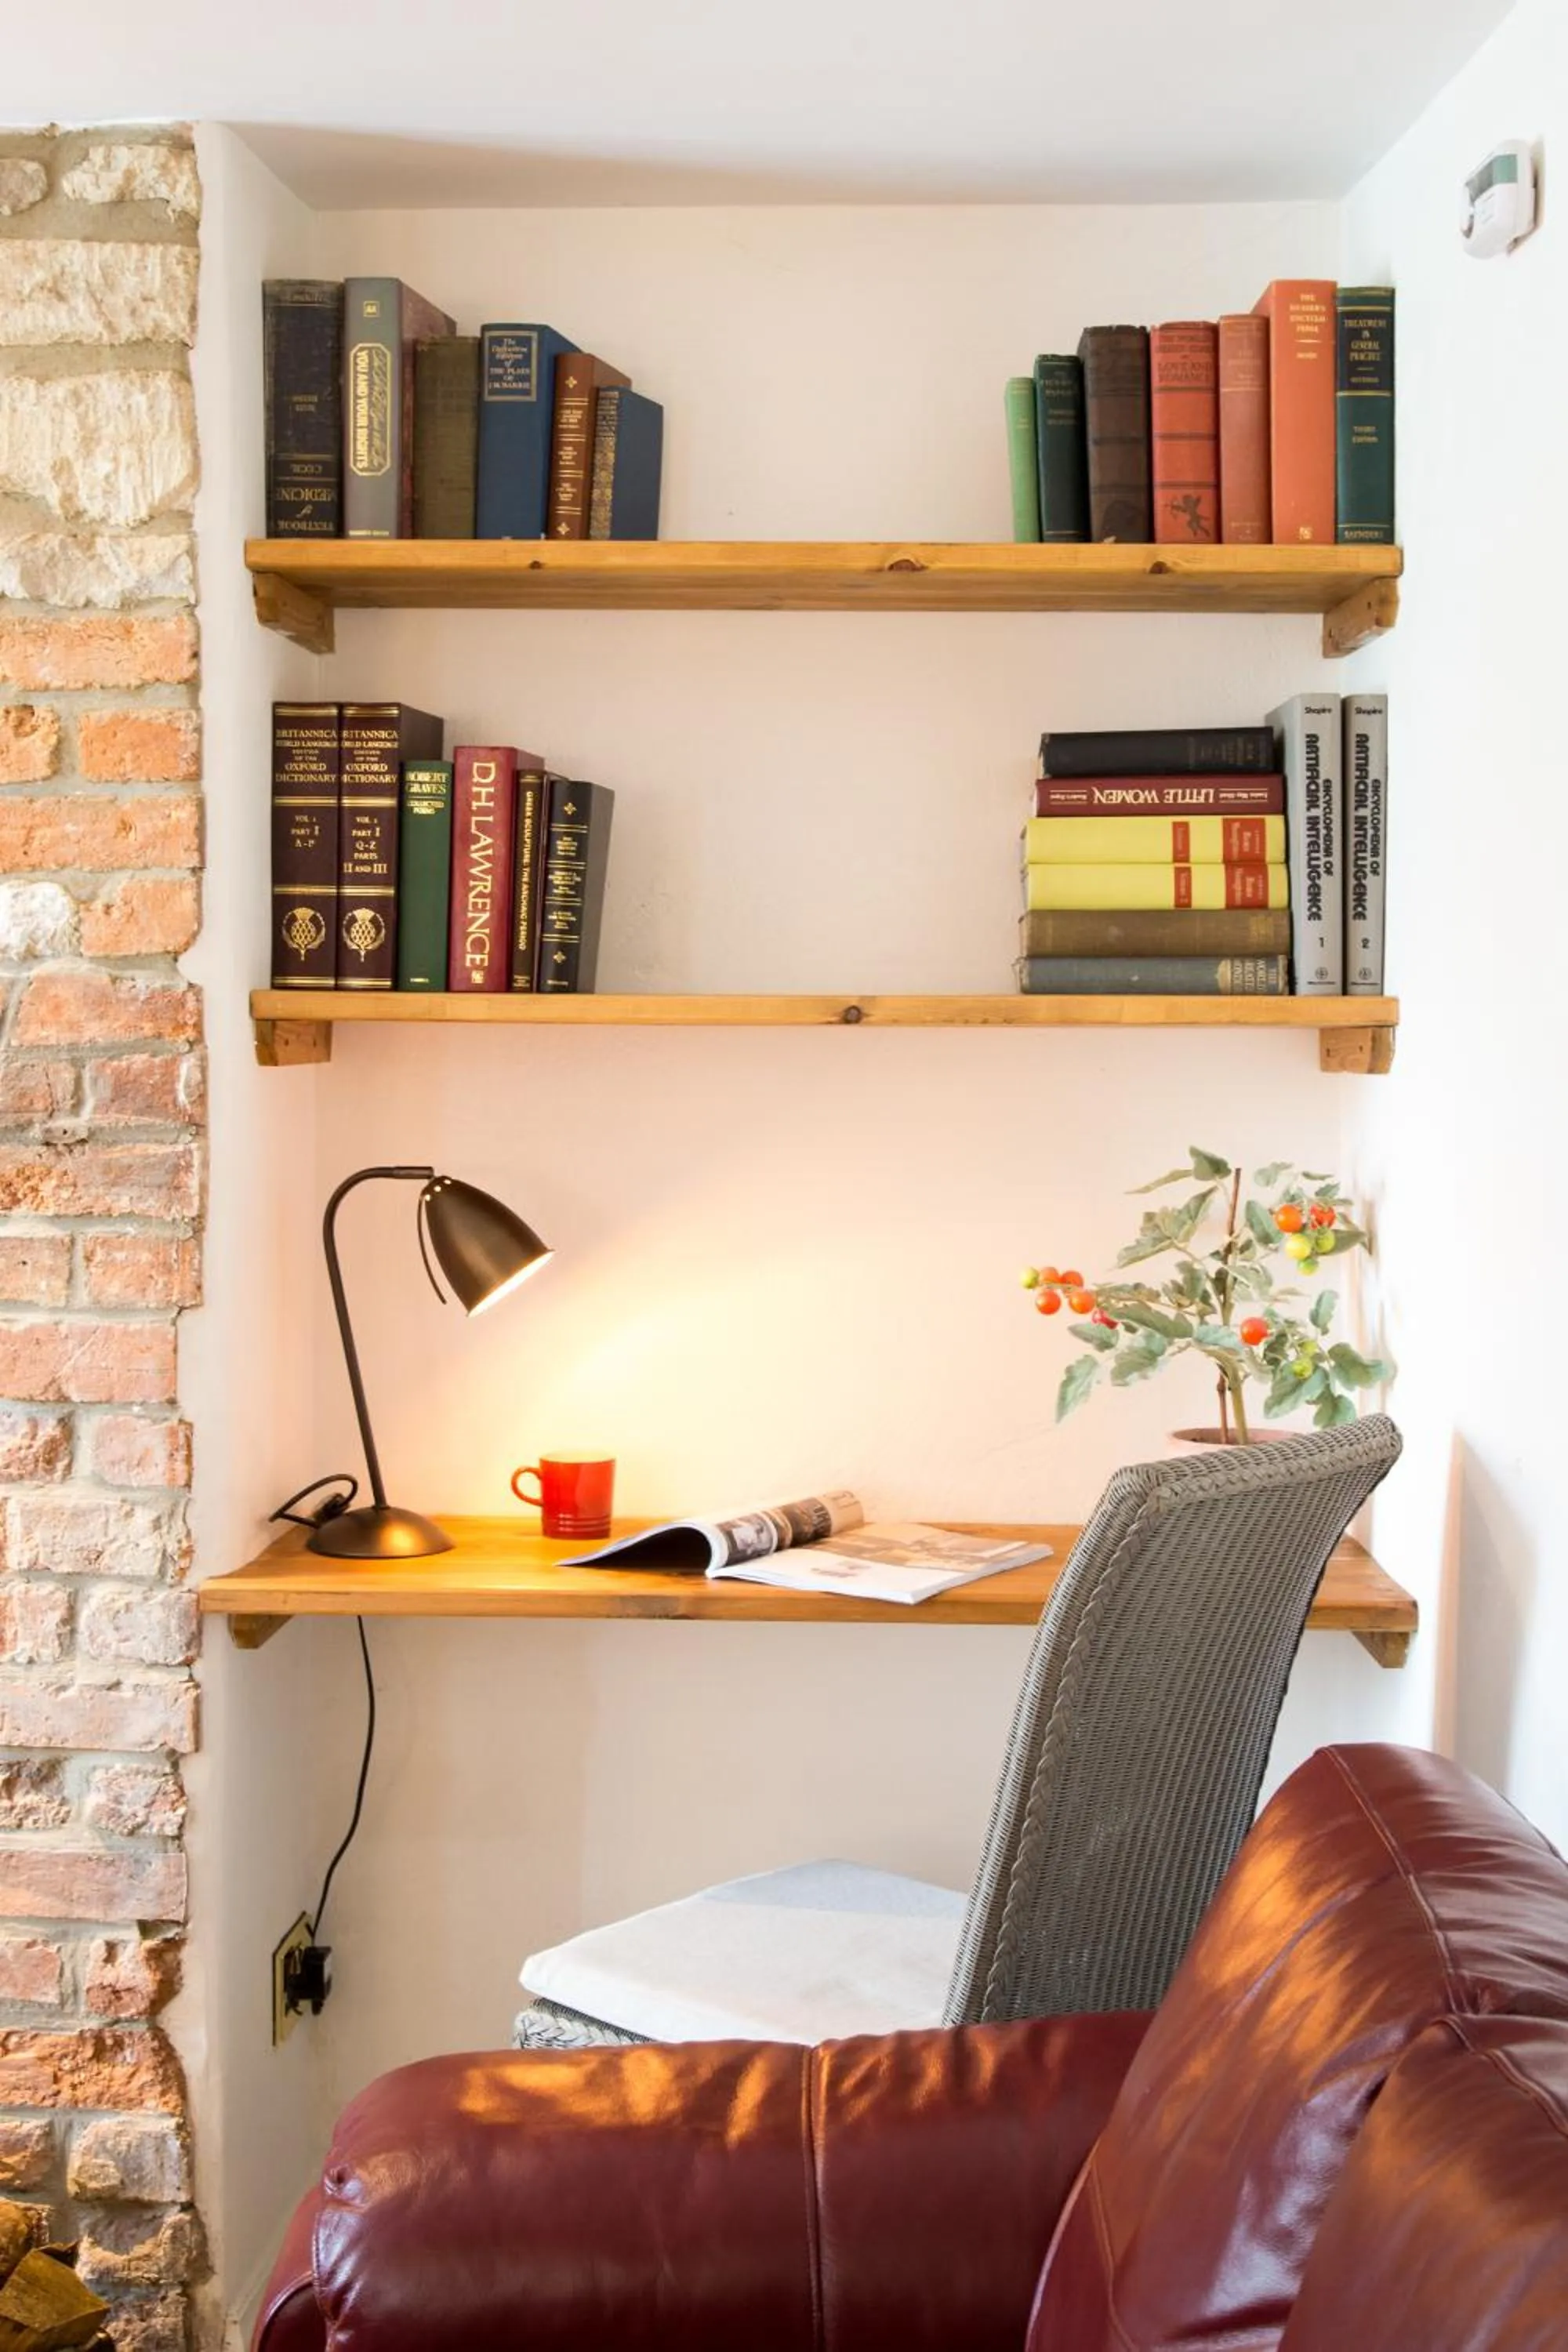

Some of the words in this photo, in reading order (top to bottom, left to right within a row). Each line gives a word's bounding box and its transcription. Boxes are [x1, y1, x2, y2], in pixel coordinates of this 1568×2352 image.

[1344, 319, 1387, 328] TREATMENT
[1350, 340, 1380, 350] GENERAL
[355, 350, 369, 372] YOU
[355, 373, 369, 397] AND
[355, 397, 369, 426] YOUR
[355, 427, 369, 469] RIGHTS
[1304, 706, 1332, 715] Shapiro
[1354, 706, 1383, 716] Shapiro
[276, 729, 337, 739] BRITANNICA
[343, 730, 398, 739] RITANNICA
[285, 763, 327, 771] OXFORD
[346, 764, 388, 772] OXFORD
[1305, 733, 1320, 812] ARTIFICIAL
[1354, 733, 1370, 812] ARTIFICIAL
[276, 773, 336, 783] DICTIONARY
[343, 774, 397, 784] ICTIONARY
[405, 771, 448, 782] ROBERT
[405, 783, 446, 794] GRAVES
[1091, 786, 1160, 804] WOMEN
[1163, 788, 1215, 804] LITTLE
[1322, 778, 1333, 858] ENCYCLOPEDIA
[1370, 778, 1381, 858] ENCYCLOPEDIA
[373, 863, 388, 873] III
[1306, 815, 1322, 921] INTELLIGENCE
[1322, 860, 1334, 876] OF
[1352, 815, 1368, 921] INTELLIGENCE
[1369, 860, 1381, 876] OF
[465, 815, 494, 967] LAWRENCE
[519, 920, 528, 950] PERIOD
